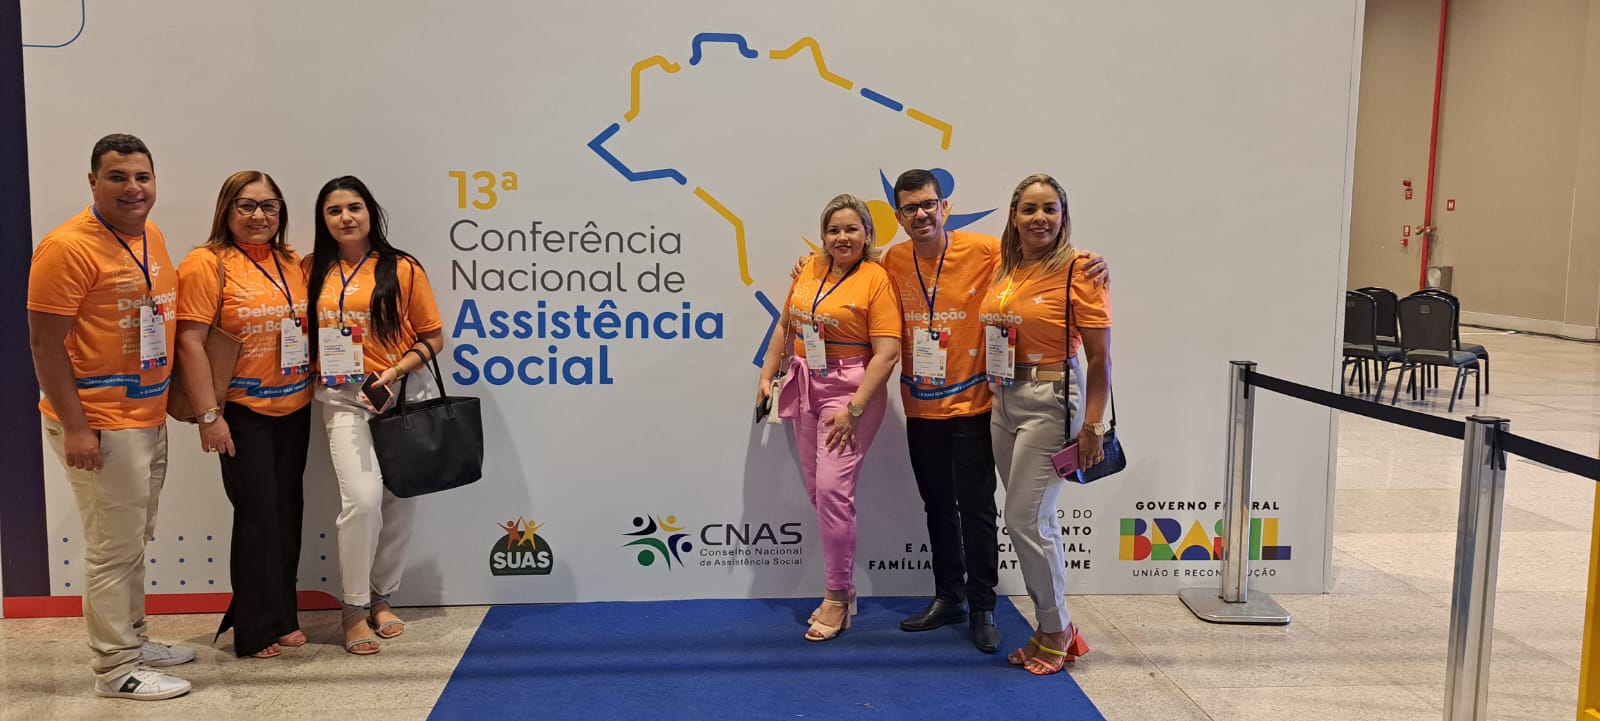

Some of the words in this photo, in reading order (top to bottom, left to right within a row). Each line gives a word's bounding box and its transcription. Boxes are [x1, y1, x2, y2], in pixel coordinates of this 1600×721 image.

[448, 170, 518, 210] 13ª
[450, 219, 681, 254] Conferência
[451, 259, 627, 292] Nacional
[637, 262, 685, 293] de
[452, 299, 724, 339] Assistência
[452, 344, 614, 386] Social
[1136, 501, 1207, 511] GOVERNO
[1214, 501, 1279, 511] FRAL
[1073, 509, 1093, 519] DO
[700, 523, 802, 546] CNAS
[700, 547, 752, 557] Conselho
[754, 546, 802, 556] Nacional
[905, 543, 912, 552] E
[493, 551, 550, 569] SUAS
[700, 559, 712, 567] de
[714, 558, 770, 567] Assistência
[772, 557, 802, 566] Social
[868, 557, 932, 570] FAMÍLIA
[1132, 567, 1169, 577] UNIÃO
[1174, 569, 1180, 577] E
[1184, 567, 1277, 578] RECONUÇÃO
